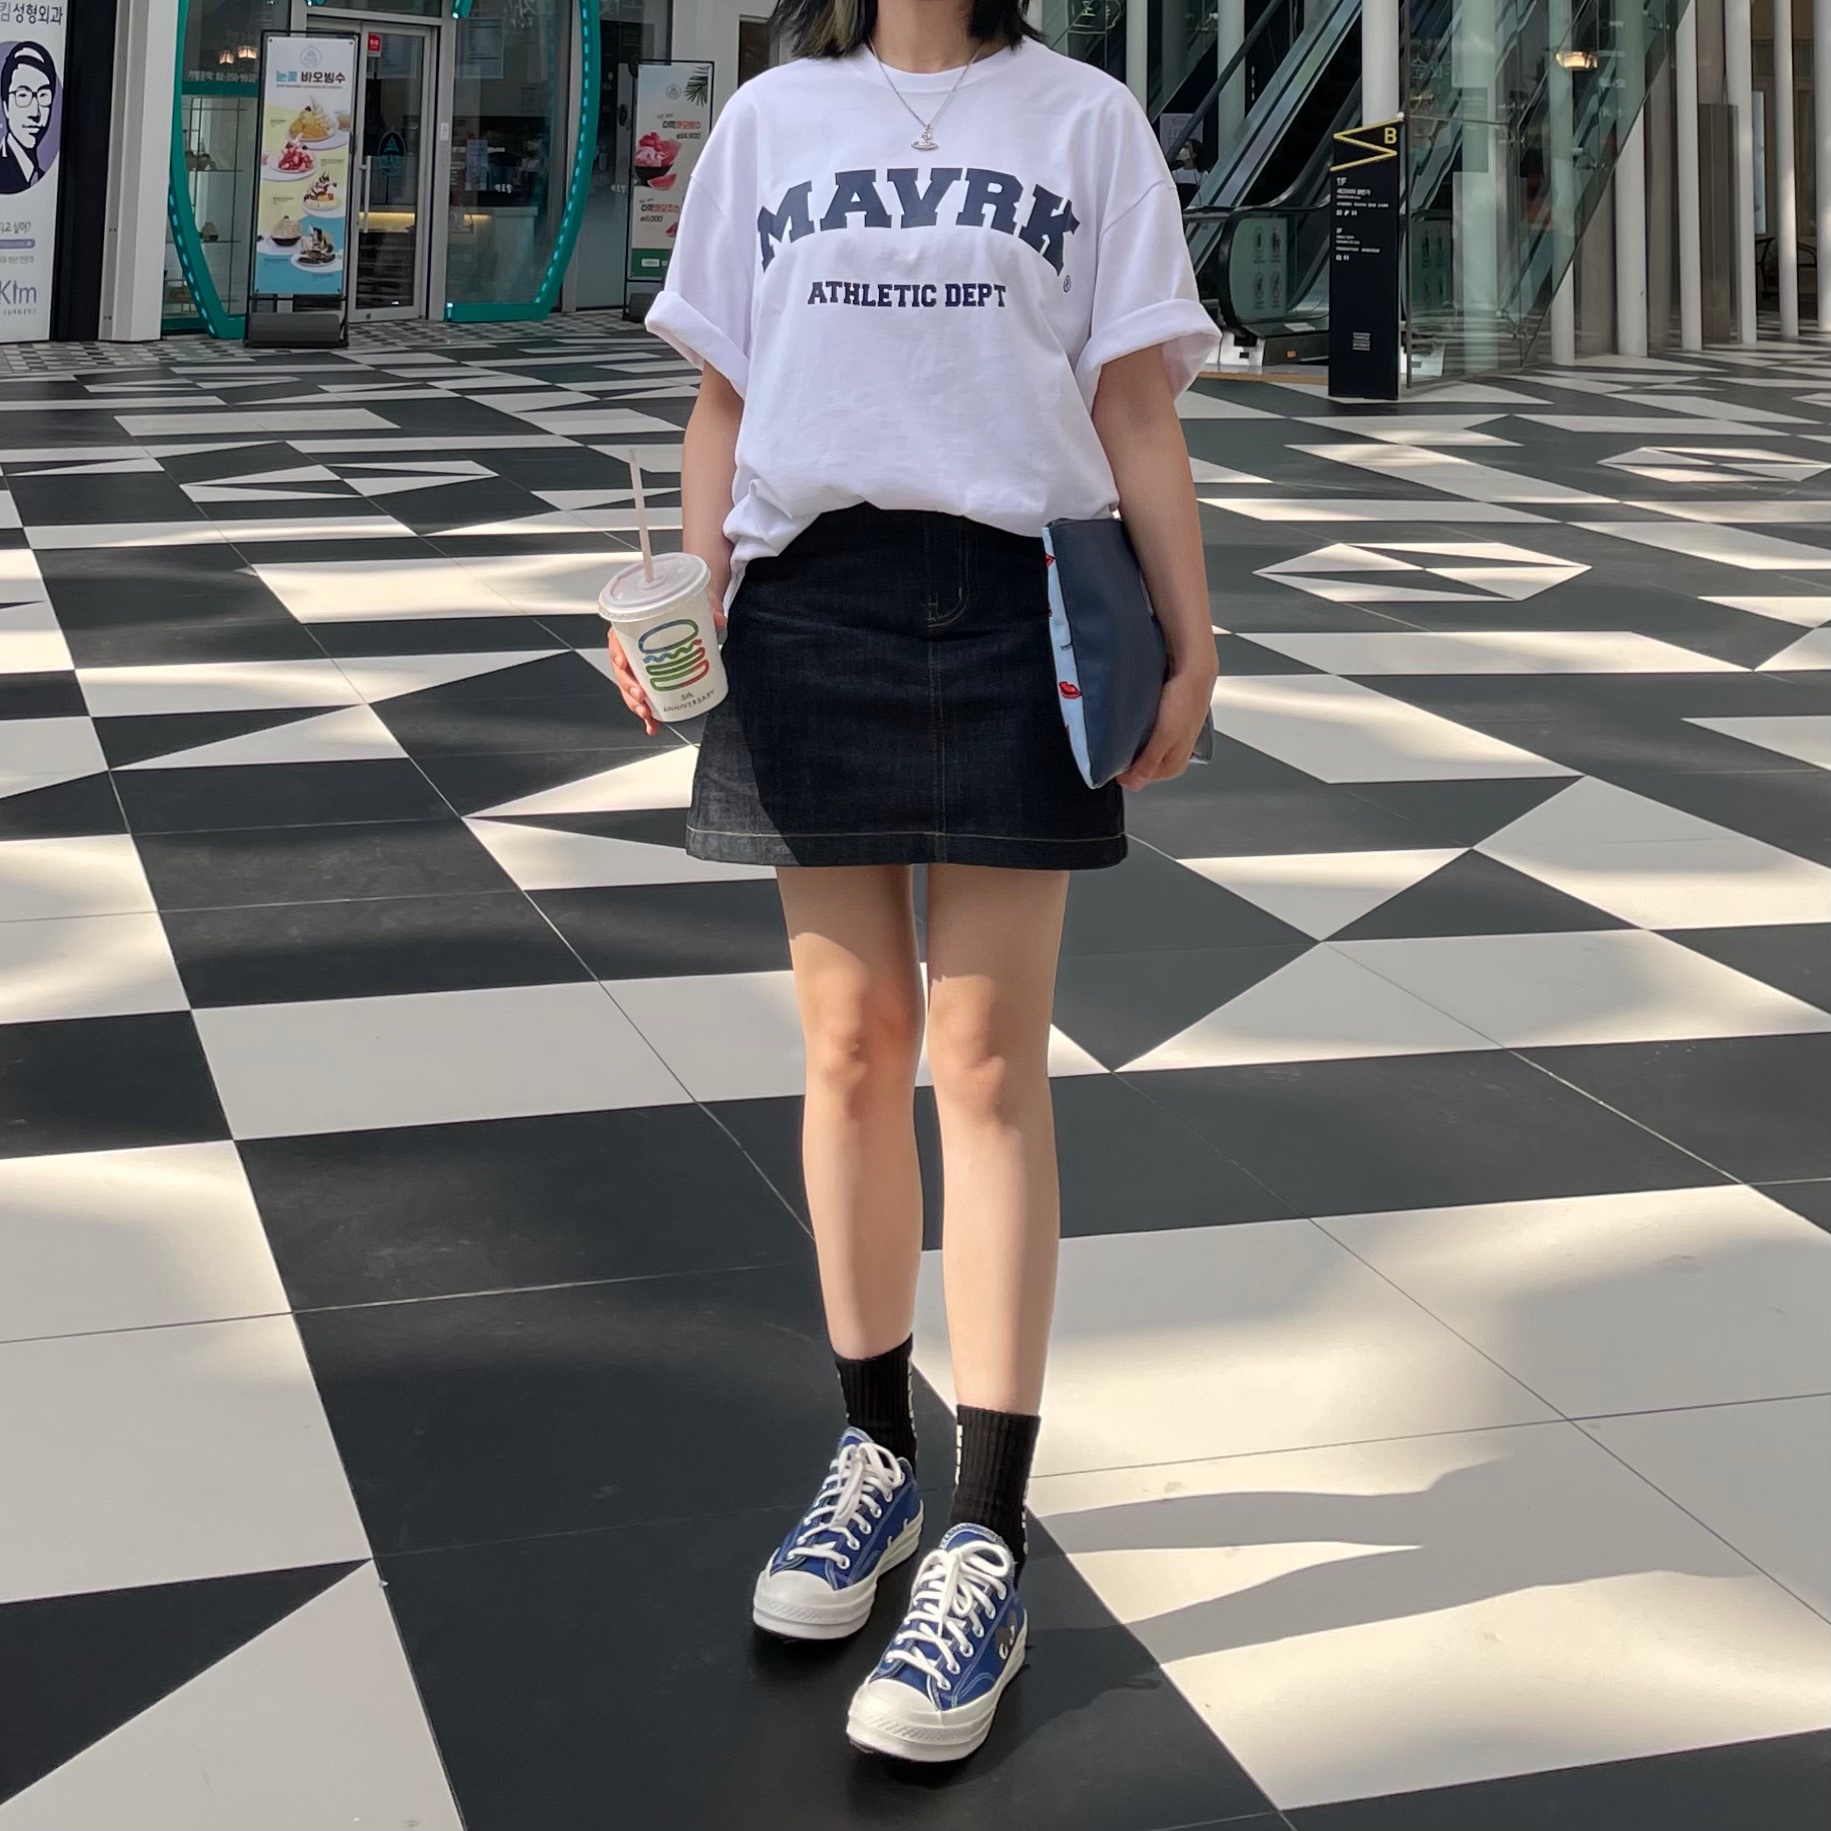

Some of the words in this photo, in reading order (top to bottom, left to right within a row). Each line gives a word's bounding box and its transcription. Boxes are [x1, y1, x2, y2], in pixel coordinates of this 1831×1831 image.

[1384, 127, 1397, 144] B
[1336, 177, 1347, 186] 1F
[807, 281, 937, 307] ATHLETIC
[945, 283, 1006, 307] DEPT
[663, 689, 714, 712] ANNIVERSARY
